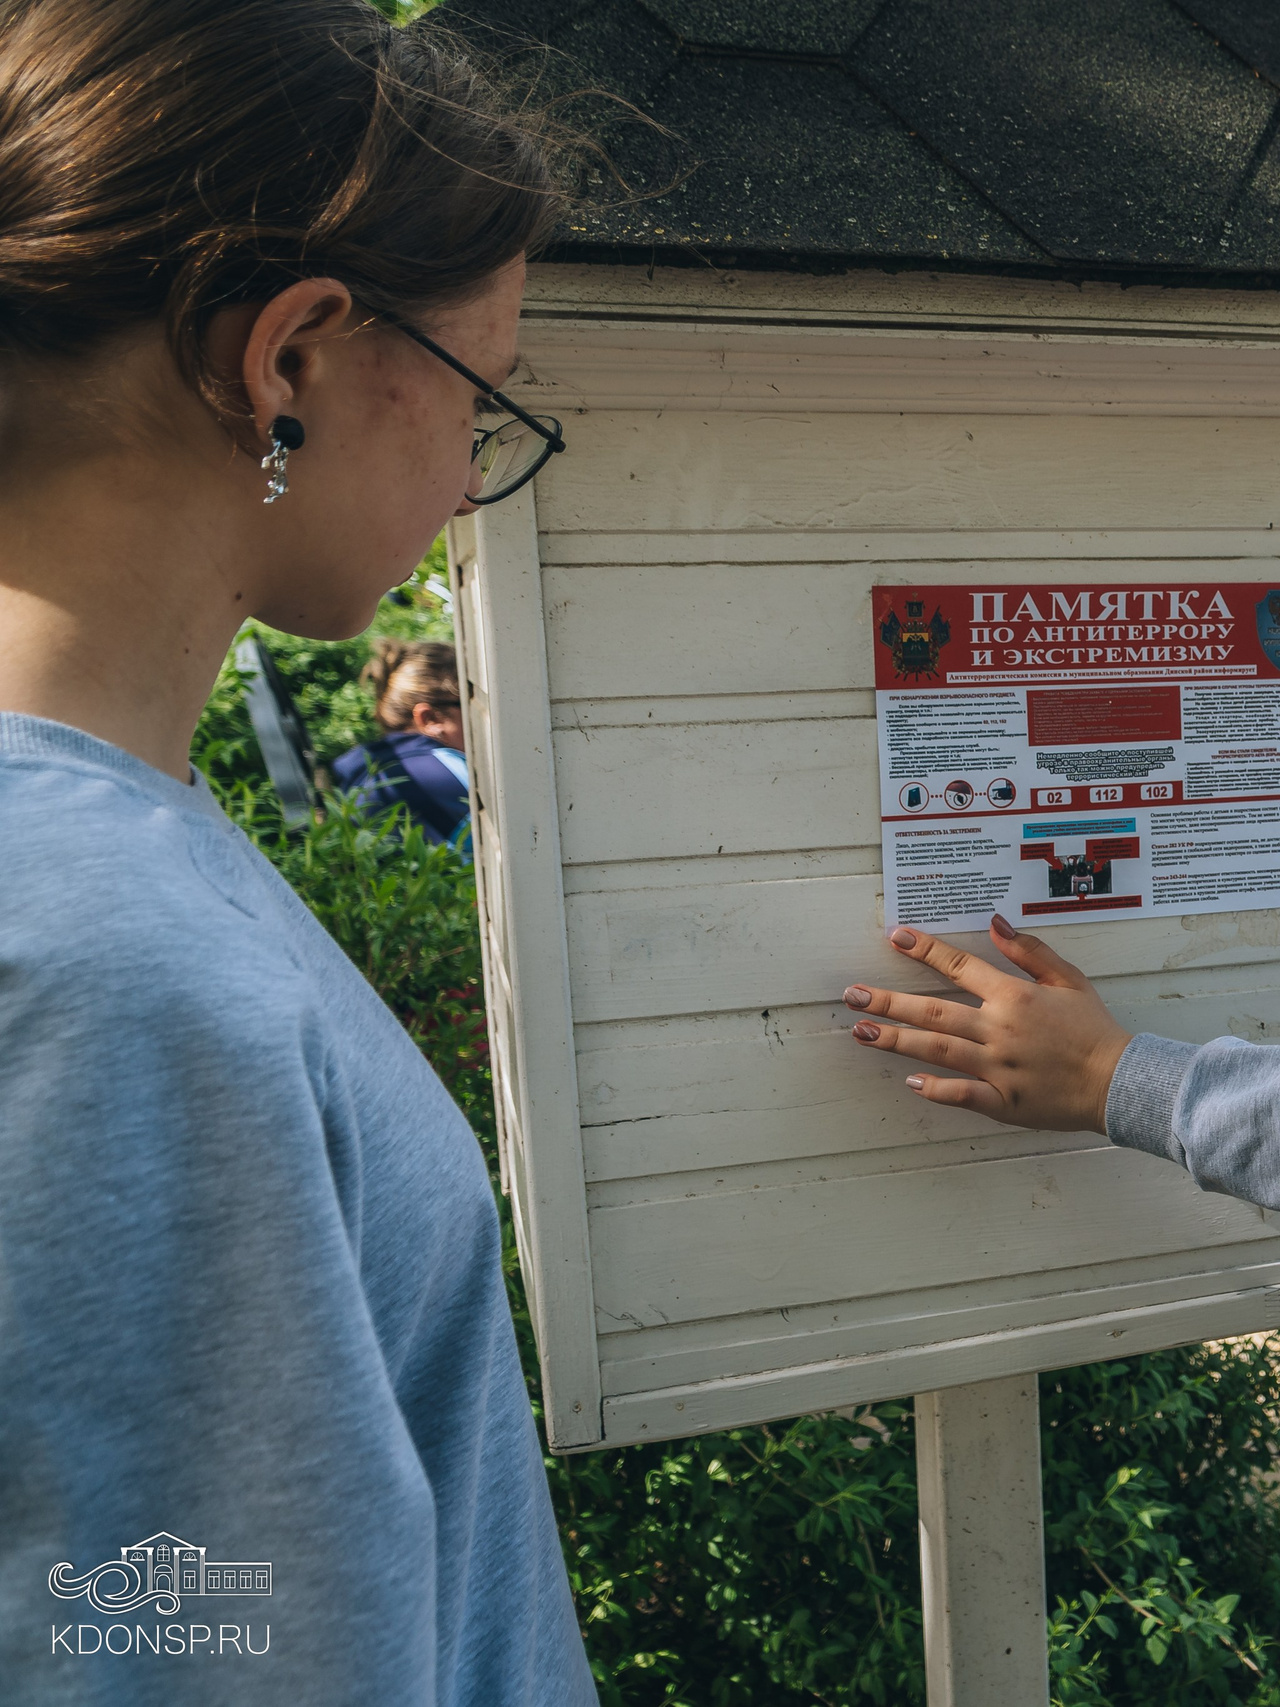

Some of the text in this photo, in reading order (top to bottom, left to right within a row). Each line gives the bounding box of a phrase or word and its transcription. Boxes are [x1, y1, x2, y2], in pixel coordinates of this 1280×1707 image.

[968, 590, 1235, 623] ПАМЯТКА
[970, 623, 1235, 645] ПО АНТИТЕРРОРУ
[971, 645, 1235, 667] И ЭКСТРЕМИЗМУ
[949, 673, 1028, 681] Антитеррористическая
[1124, 669, 1164, 677] образовании
[1084, 750, 1120, 758] сообщите
[1126, 747, 1173, 758] поступившей
[1037, 761, 1062, 769] угрозе
[1070, 756, 1146, 768] правоохранительные
[1147, 755, 1176, 763] органы.
[1116, 762, 1165, 772] предупредить
[1066, 772, 1133, 781] террористический
[1047, 786, 1168, 804] 02 112 102
